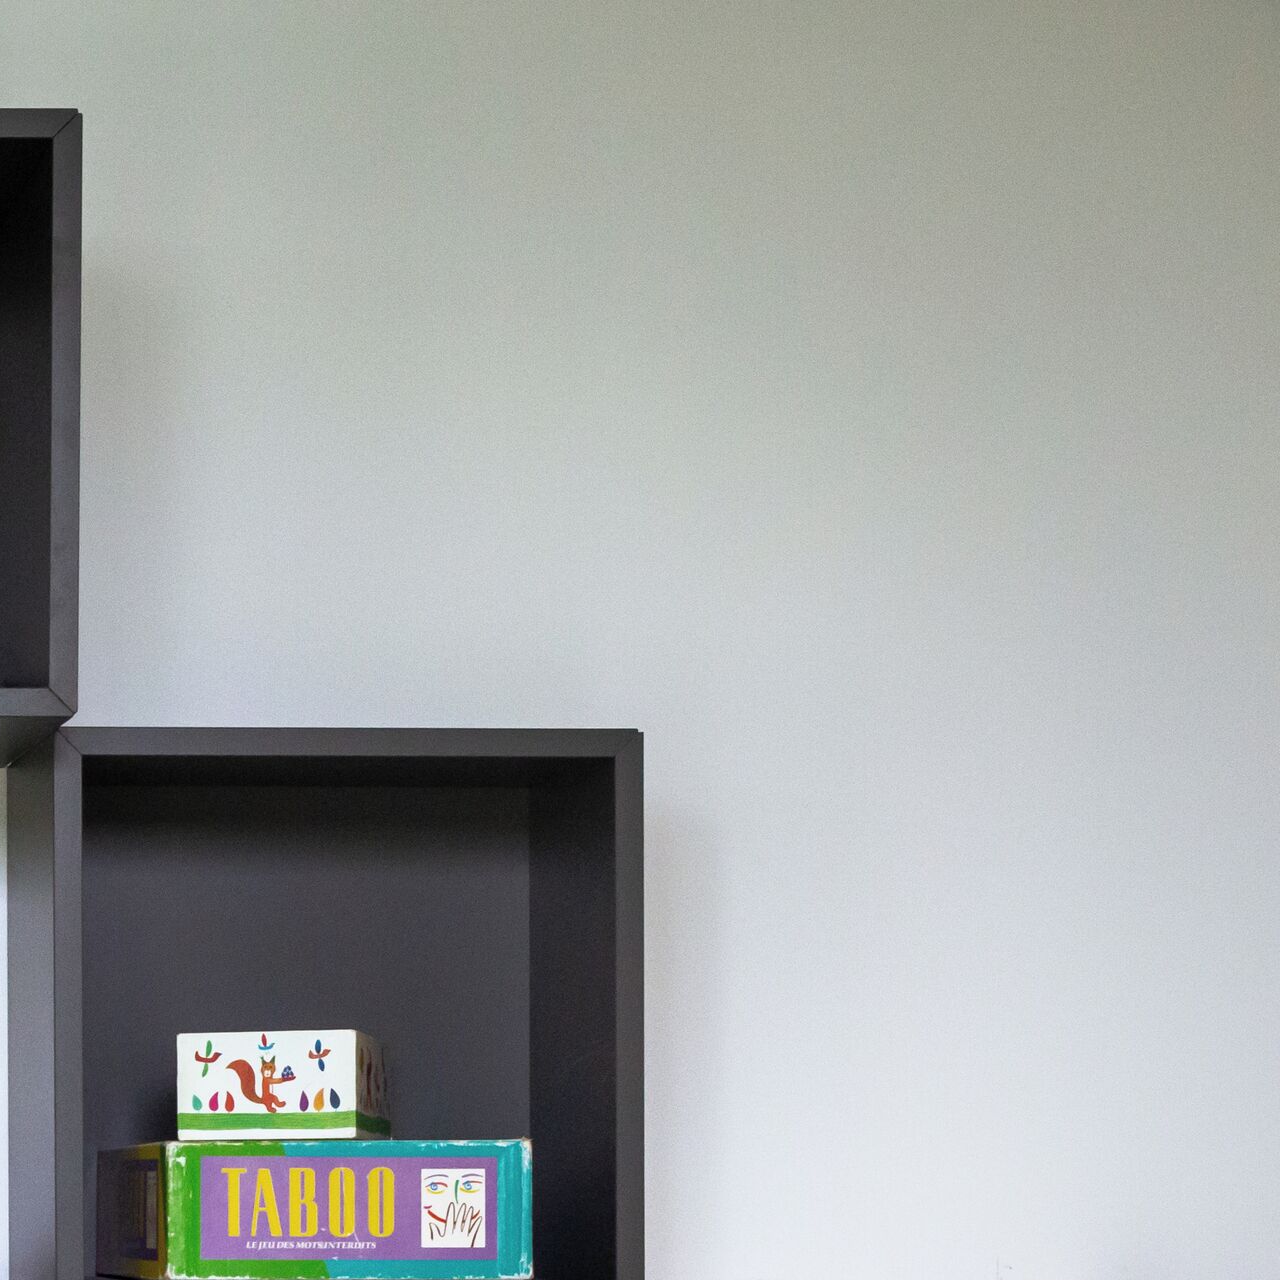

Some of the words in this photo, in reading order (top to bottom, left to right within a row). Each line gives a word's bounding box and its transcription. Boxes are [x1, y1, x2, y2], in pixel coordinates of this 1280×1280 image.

[221, 1167, 395, 1237] TABOO
[246, 1241, 258, 1249] LE
[257, 1241, 277, 1251] JEU
[277, 1241, 296, 1249] DES
[323, 1241, 376, 1250] INTERDITS
